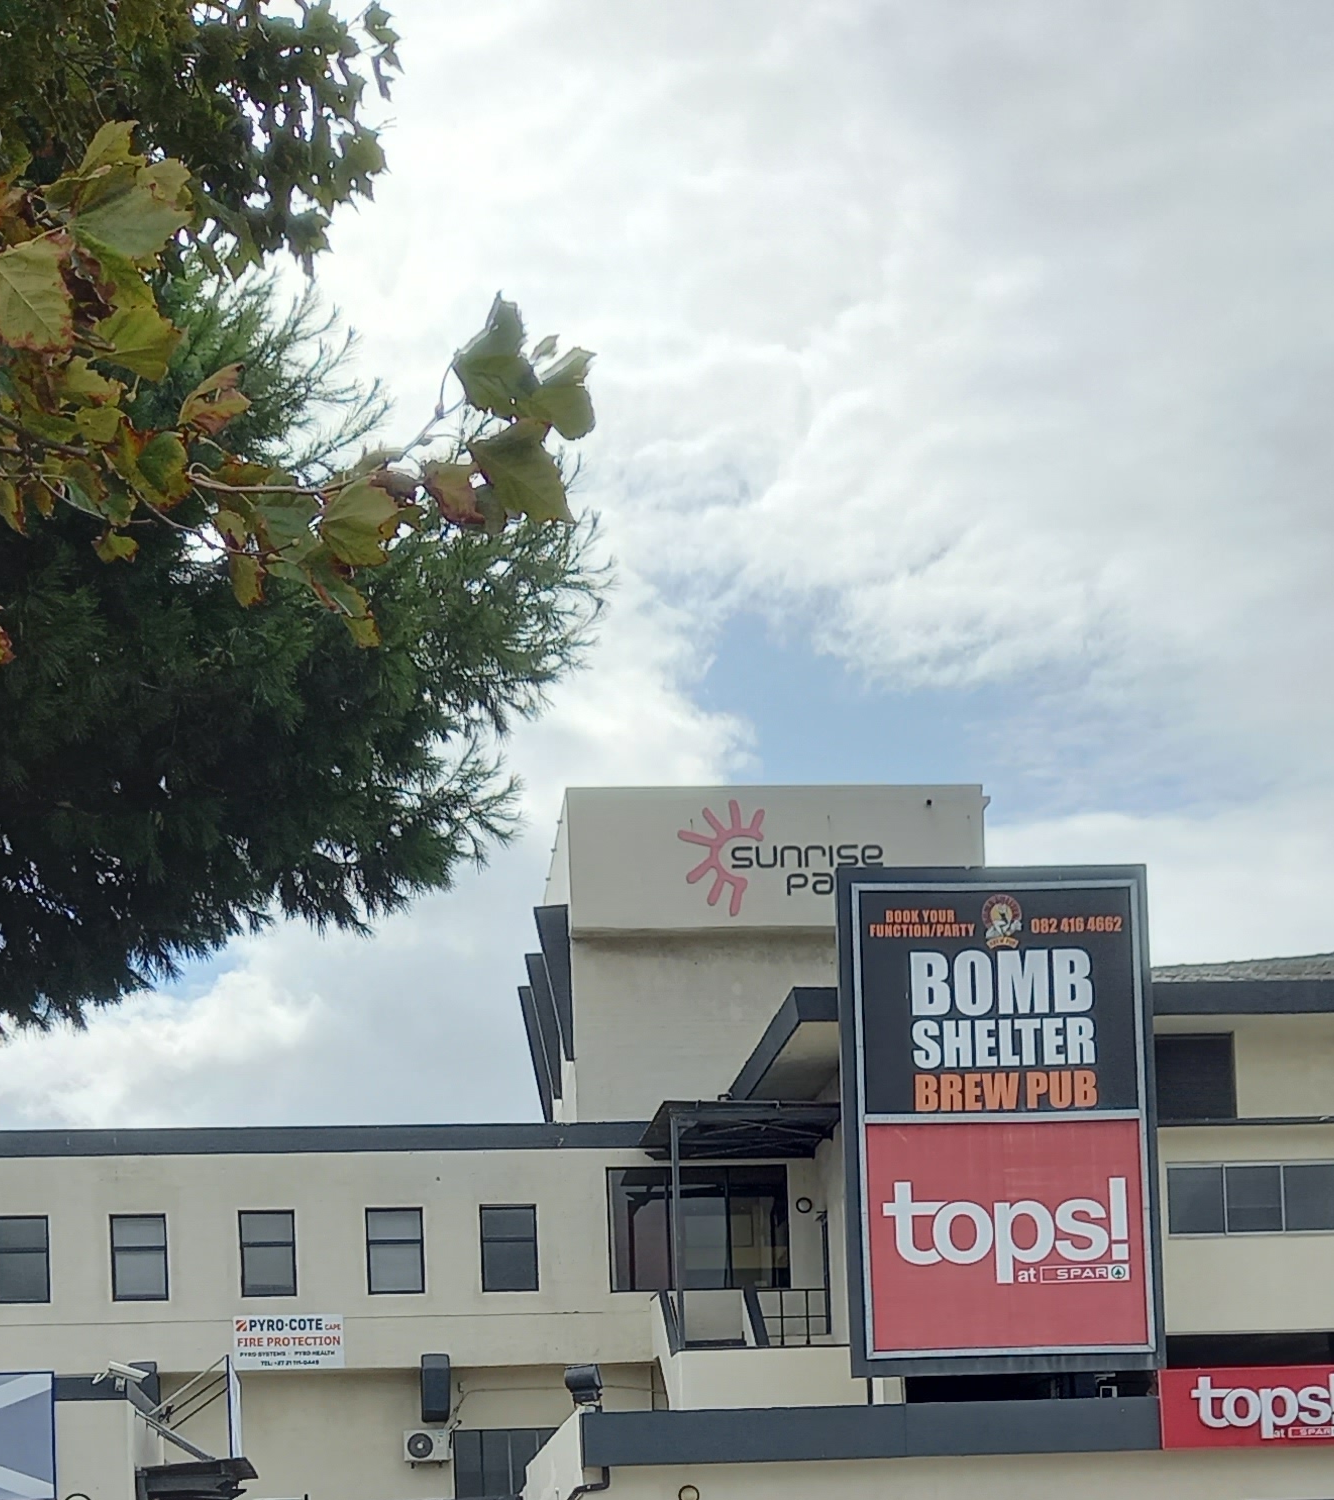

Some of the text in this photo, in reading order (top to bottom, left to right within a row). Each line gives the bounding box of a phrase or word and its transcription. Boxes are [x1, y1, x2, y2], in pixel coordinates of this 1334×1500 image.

[786, 872, 835, 896] pa
[885, 909, 956, 923] BOOK YOUR
[869, 923, 976, 938] FUNCTION/PARTY
[1030, 916, 1123, 934] 082 416 4662
[909, 948, 1094, 1016] BOMB
[911, 1017, 1097, 1069] SHELTER
[914, 1070, 1098, 1112] BREW PUB
[882, 1176, 1130, 1285] tops!
[1017, 1267, 1108, 1283] at SPAR
[325, 1323, 341, 1331] CAPE
[237, 1335, 341, 1347] FIRE PROTECTION
[1273, 1428, 1331, 1439] at SPAR
